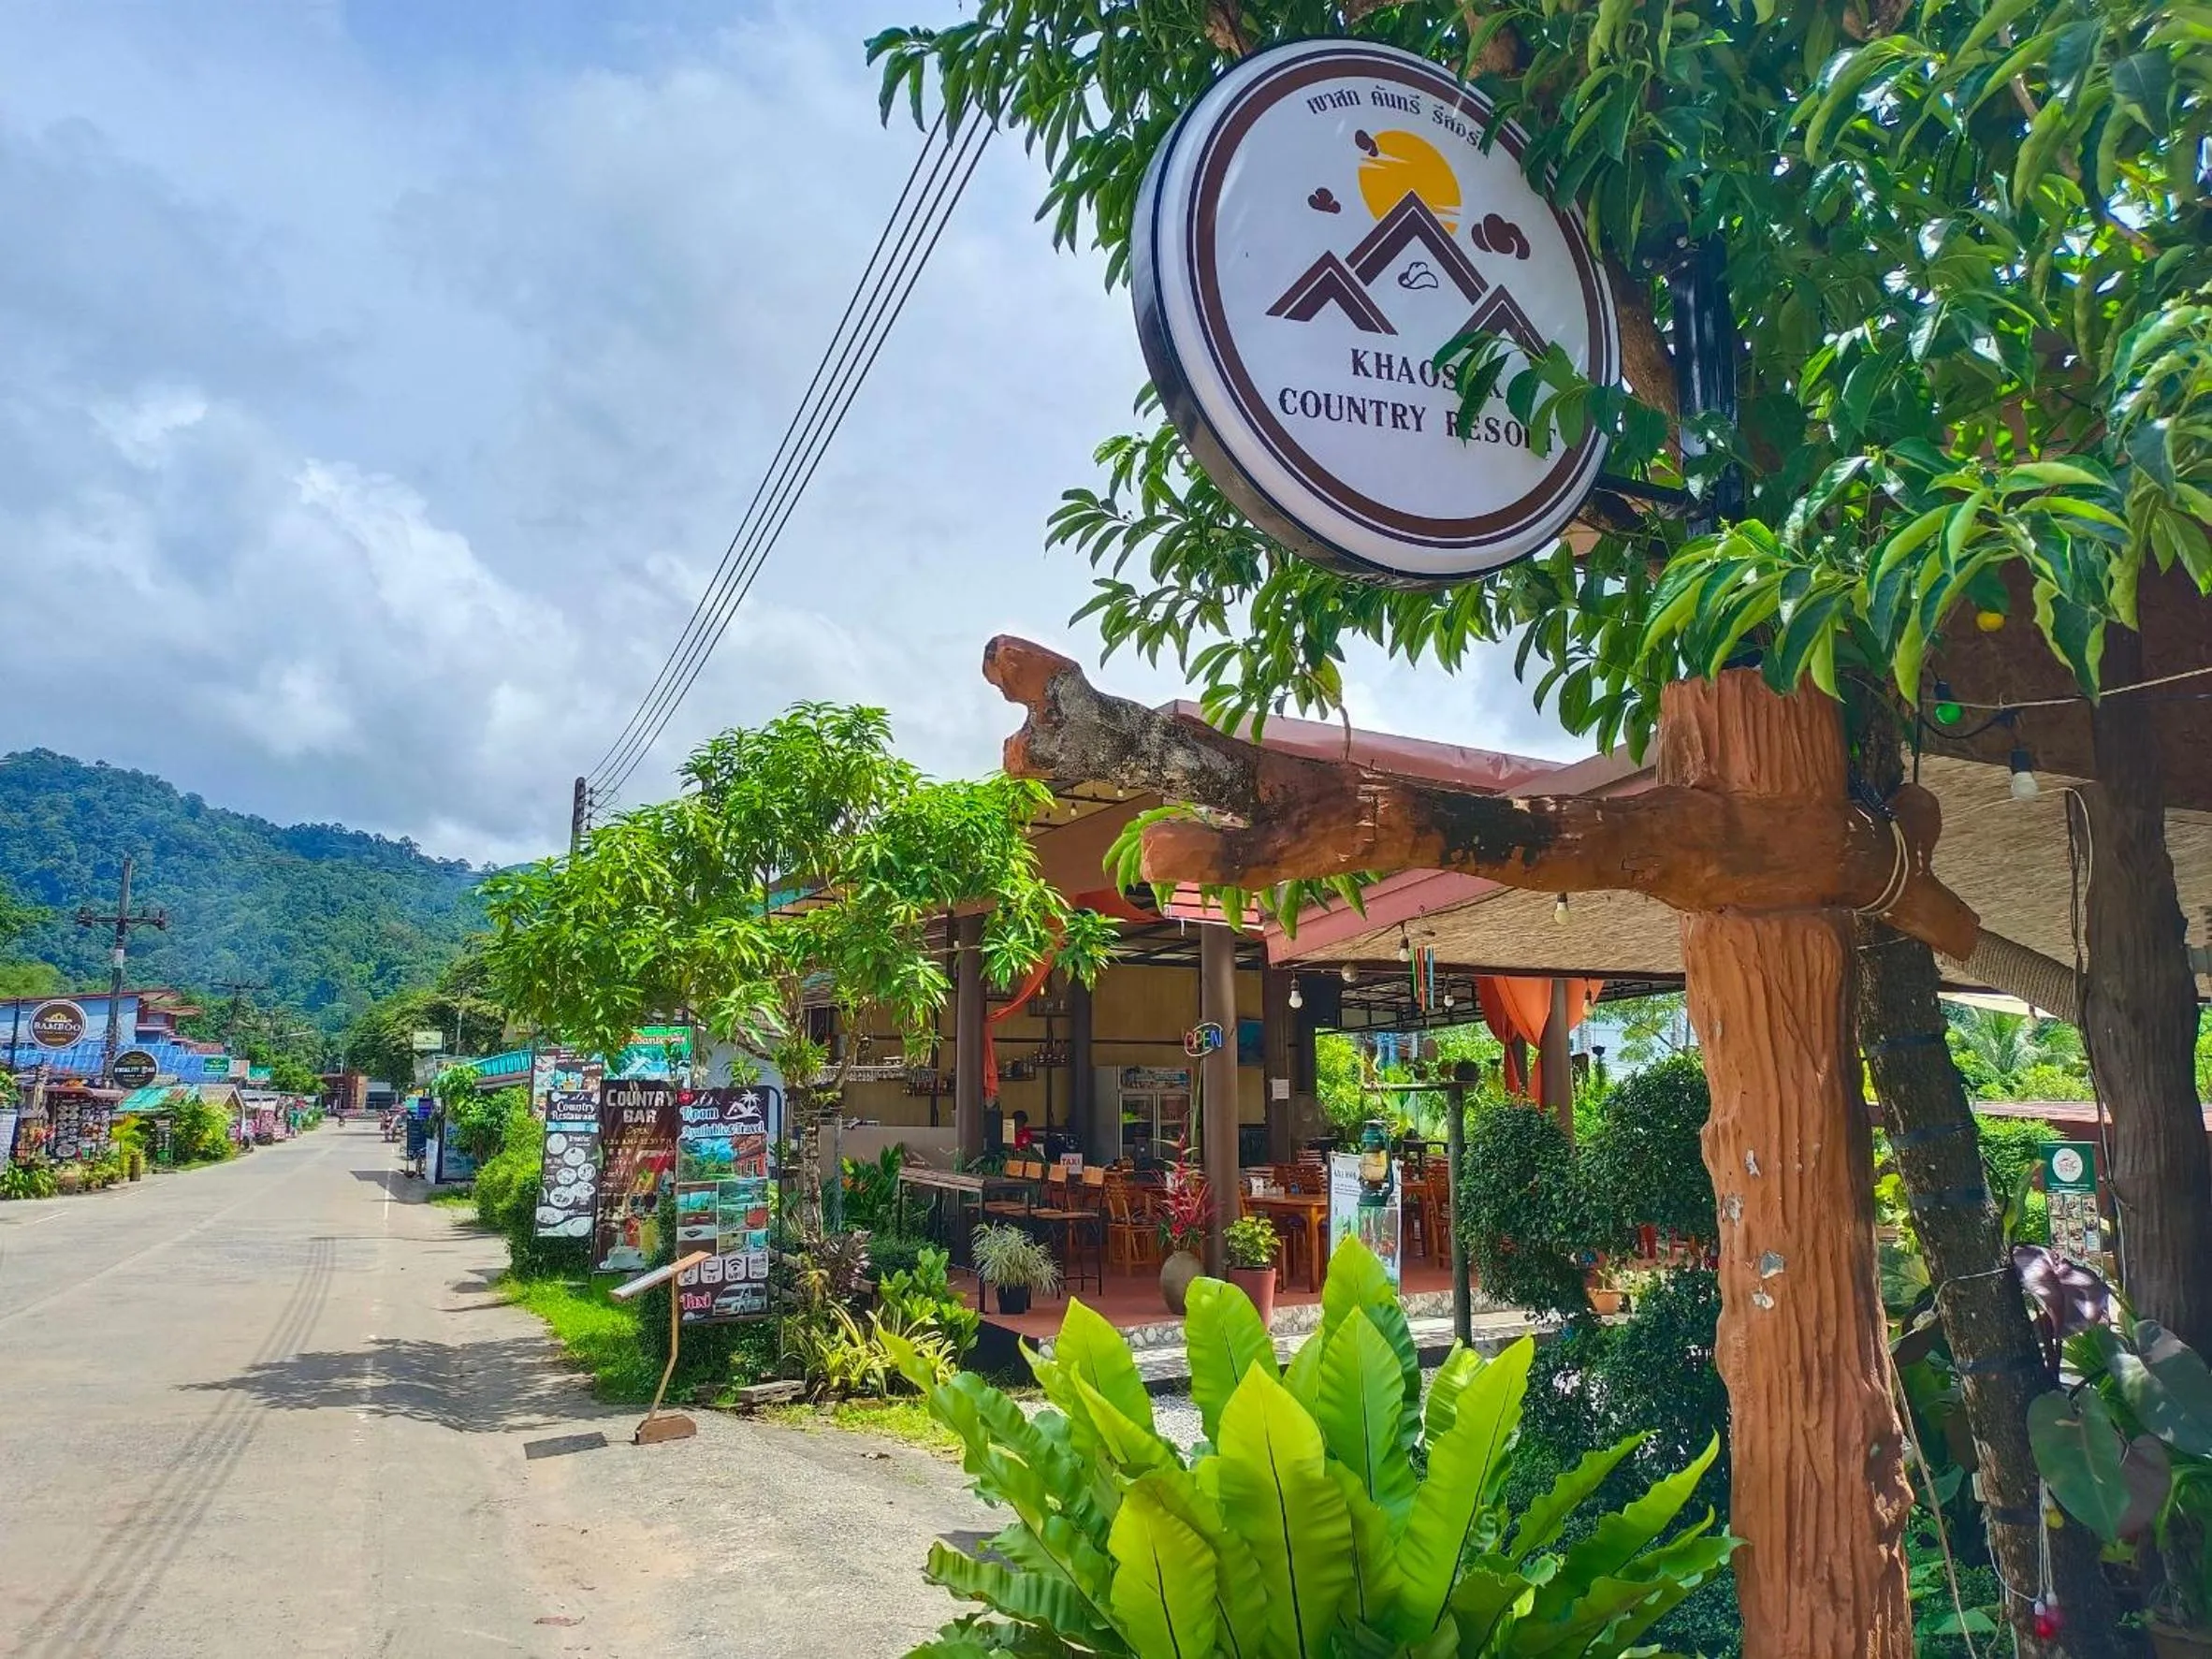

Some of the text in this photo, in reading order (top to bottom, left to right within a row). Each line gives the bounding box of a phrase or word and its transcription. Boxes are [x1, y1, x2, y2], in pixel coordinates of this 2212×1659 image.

[1432, 104, 1490, 156] รีสอร์
[1350, 348, 1505, 400] KHAOSK
[1278, 386, 1427, 432] COUNTRY
[1184, 1029, 1222, 1050] OPEN
[557, 1101, 595, 1113] Country
[605, 1088, 675, 1107] COUNTRY
[551, 1110, 597, 1121] Restaurant
[623, 1109, 657, 1123] BAR
[679, 1106, 720, 1123] Room
[1062, 1157, 1081, 1166] TAXI
[680, 1291, 711, 1310] Taxi
